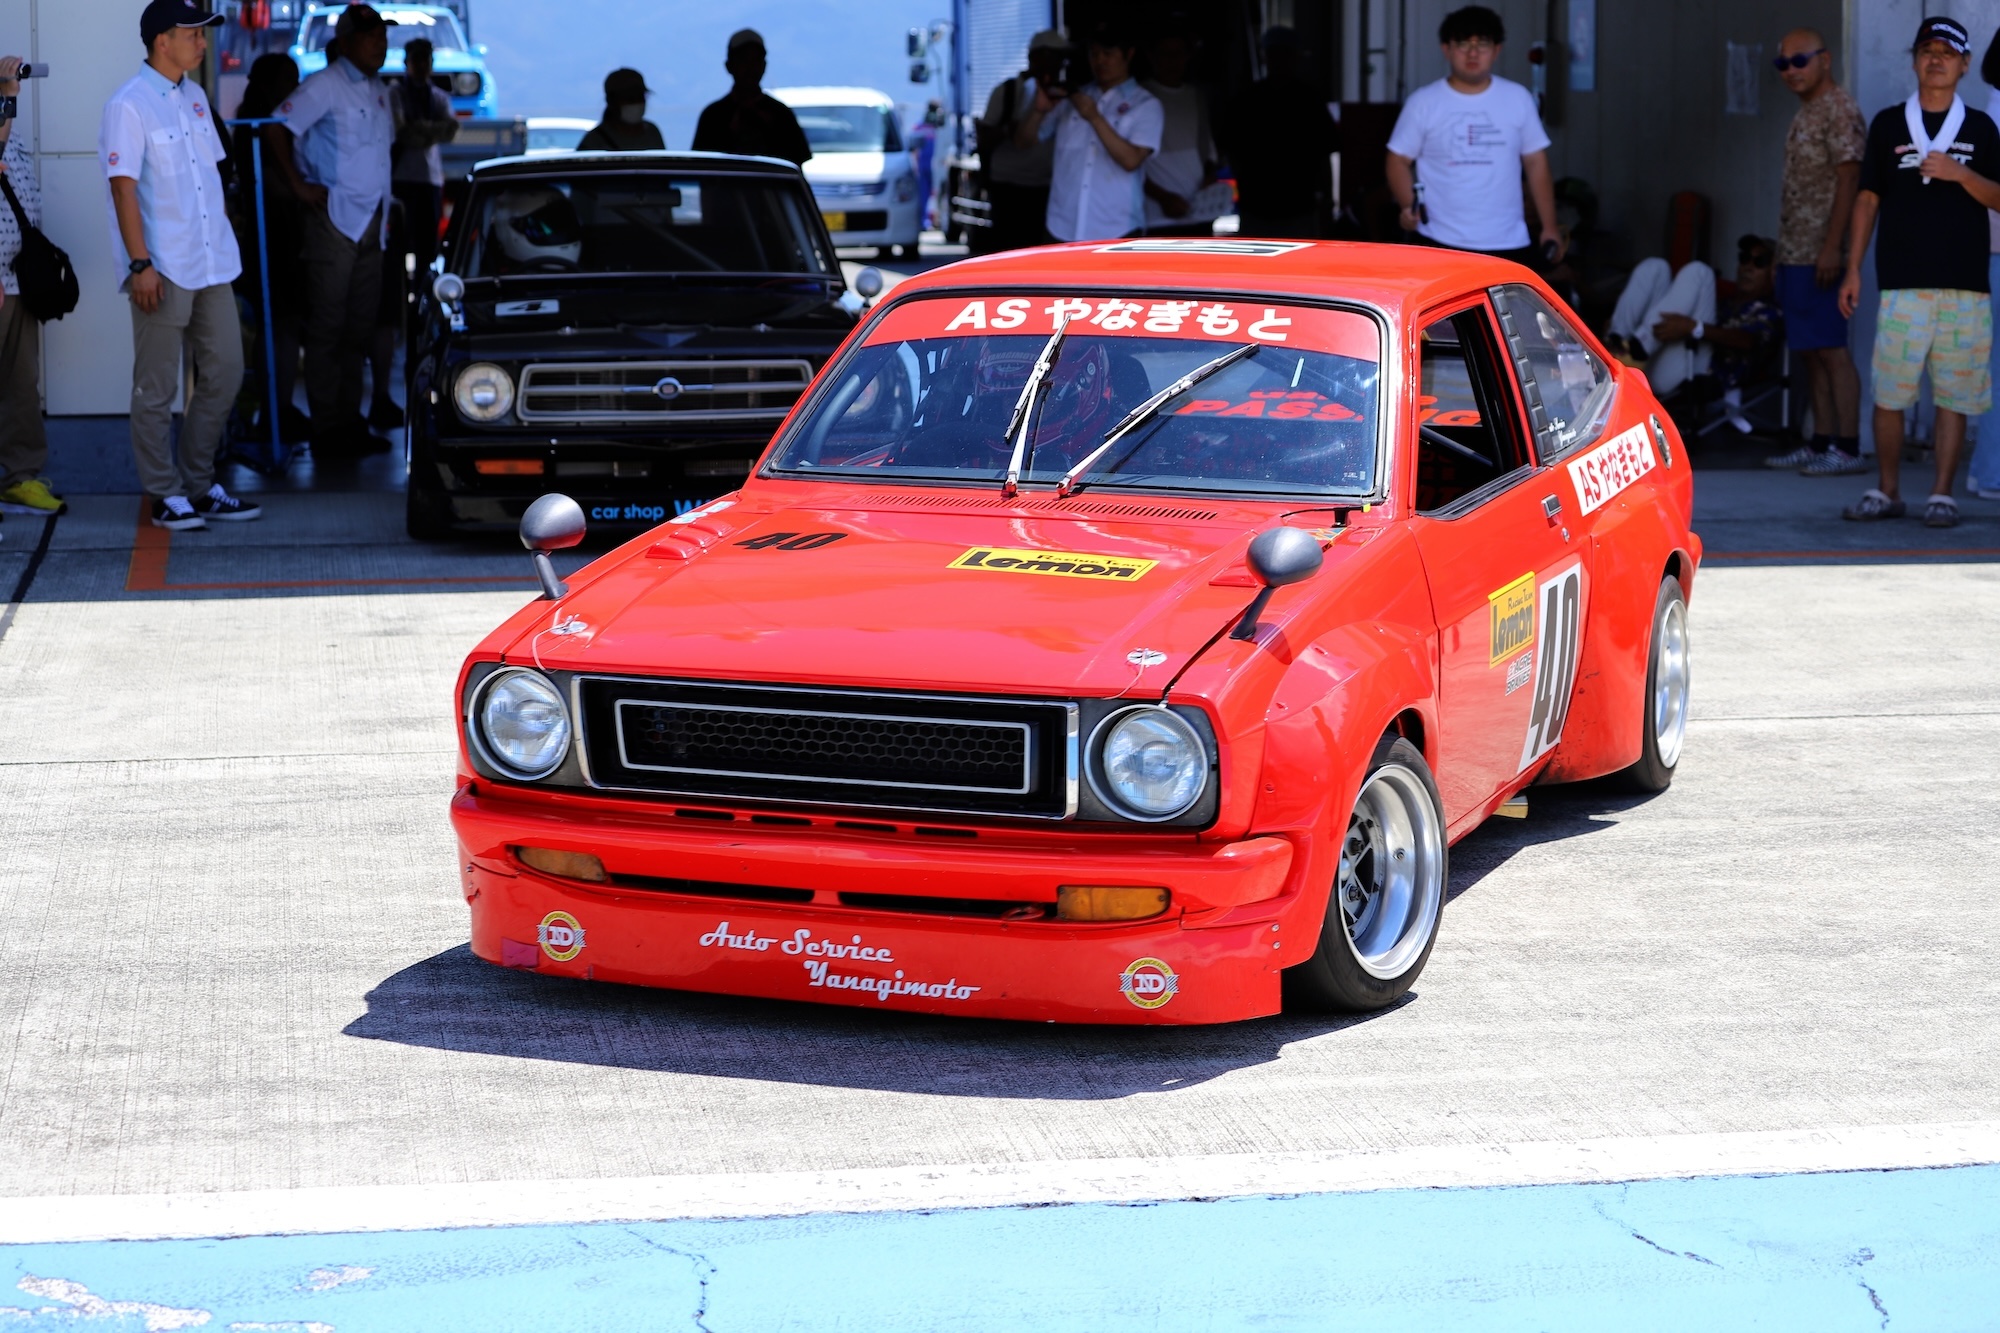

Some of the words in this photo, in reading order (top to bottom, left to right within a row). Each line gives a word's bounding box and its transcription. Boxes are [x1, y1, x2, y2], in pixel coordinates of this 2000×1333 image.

[944, 298, 1031, 331] AS
[1044, 297, 1292, 342] やなぎもと
[591, 507, 619, 519] car
[624, 504, 664, 521] shop
[733, 532, 849, 551] 40
[961, 551, 1137, 577] Lemon
[1492, 604, 1533, 658] Lemon
[1530, 573, 1579, 759] 40
[699, 921, 778, 951] Auto
[781, 928, 895, 963] Service
[803, 960, 981, 1001] Yanagimoto
